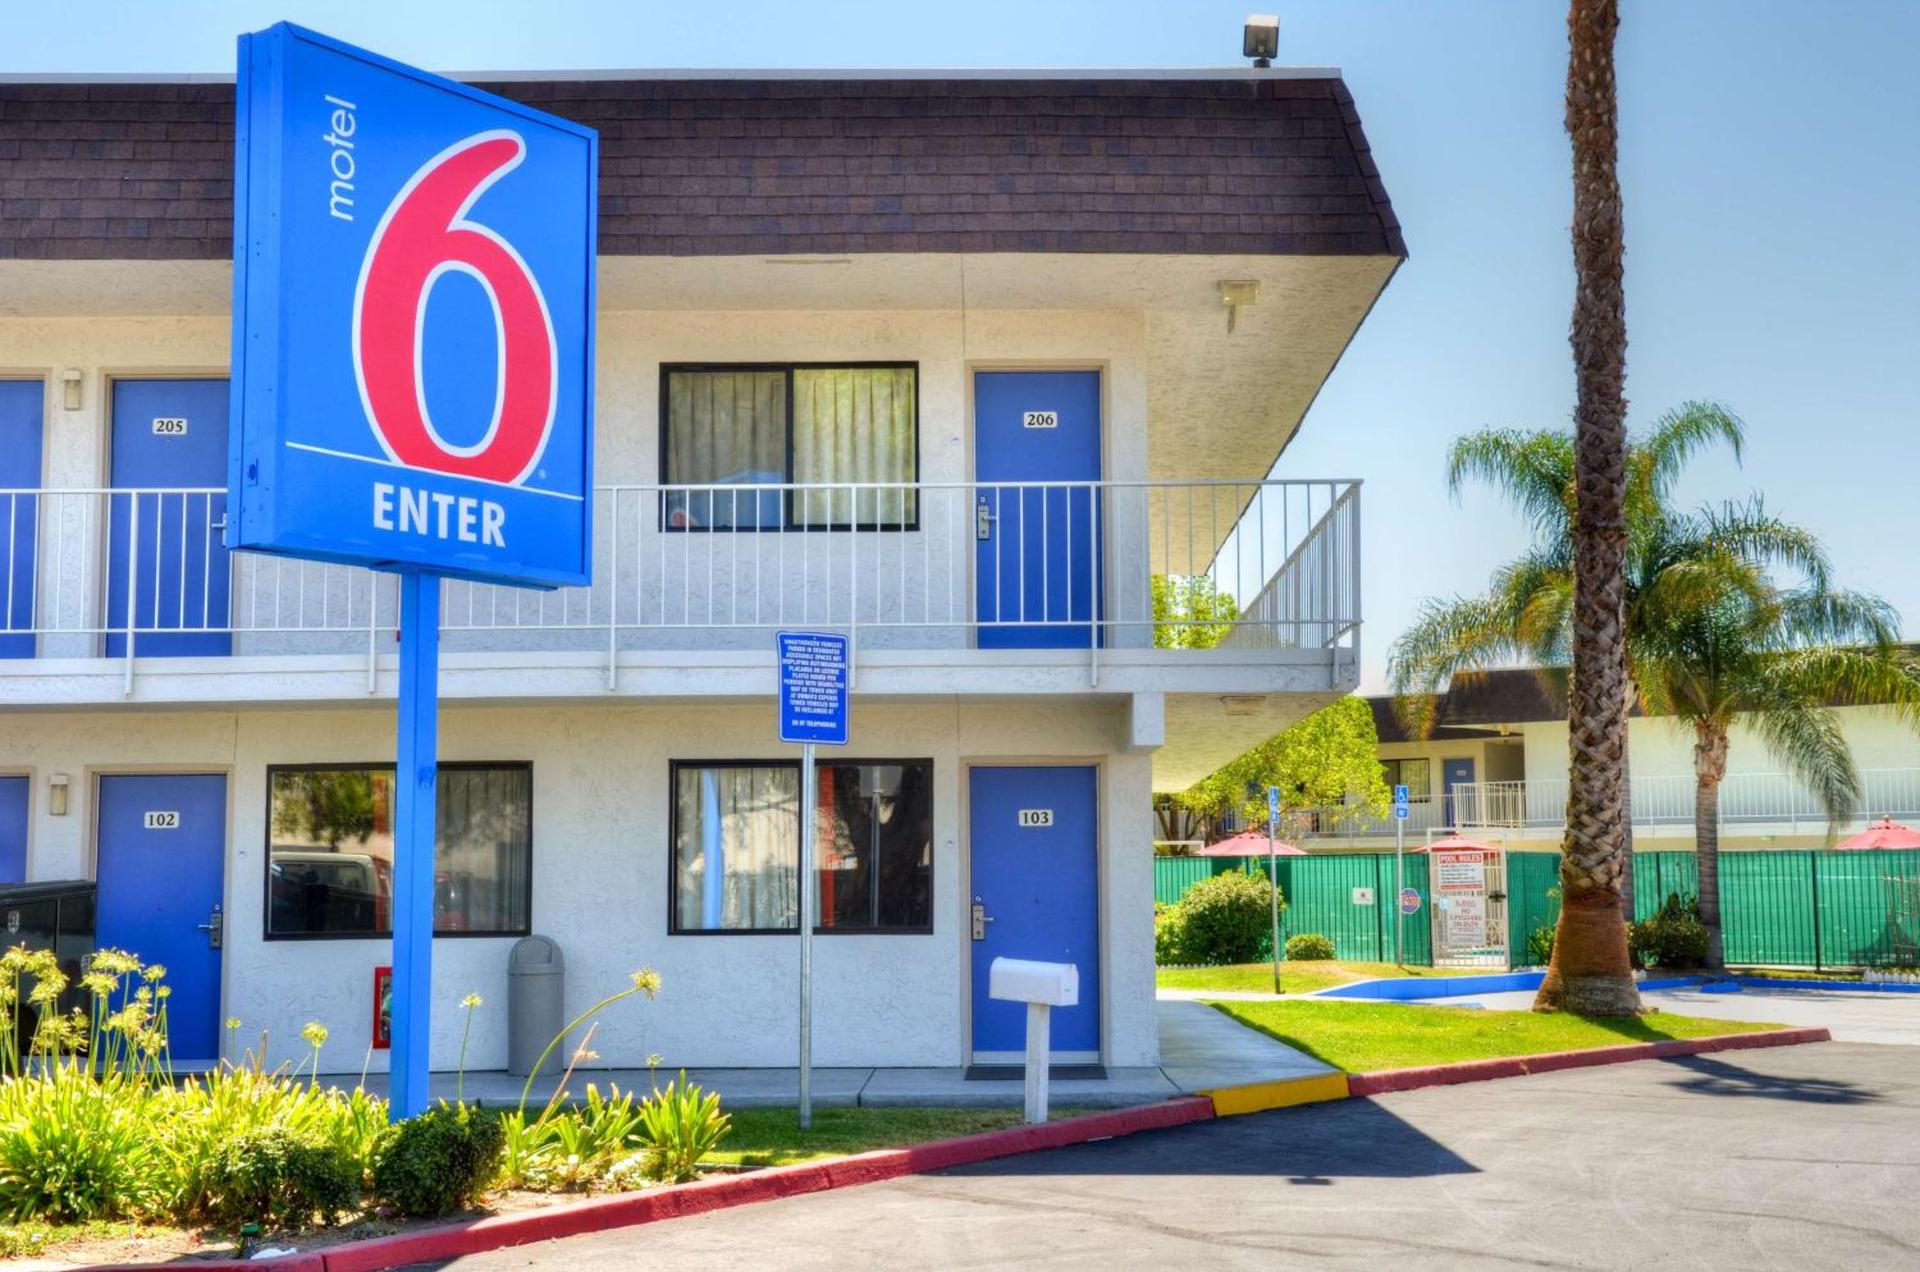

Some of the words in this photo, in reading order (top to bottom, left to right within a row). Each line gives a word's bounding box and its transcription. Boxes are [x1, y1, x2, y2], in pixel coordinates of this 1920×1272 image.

[324, 94, 357, 221] motel
[351, 128, 559, 488] 6
[156, 420, 184, 432] 205
[1027, 414, 1054, 426] 206
[373, 481, 506, 548] ENTER
[148, 813, 175, 826] 102
[1023, 812, 1049, 824] 103
[1440, 855, 1456, 863] POOL
[1457, 854, 1481, 862] RULES
